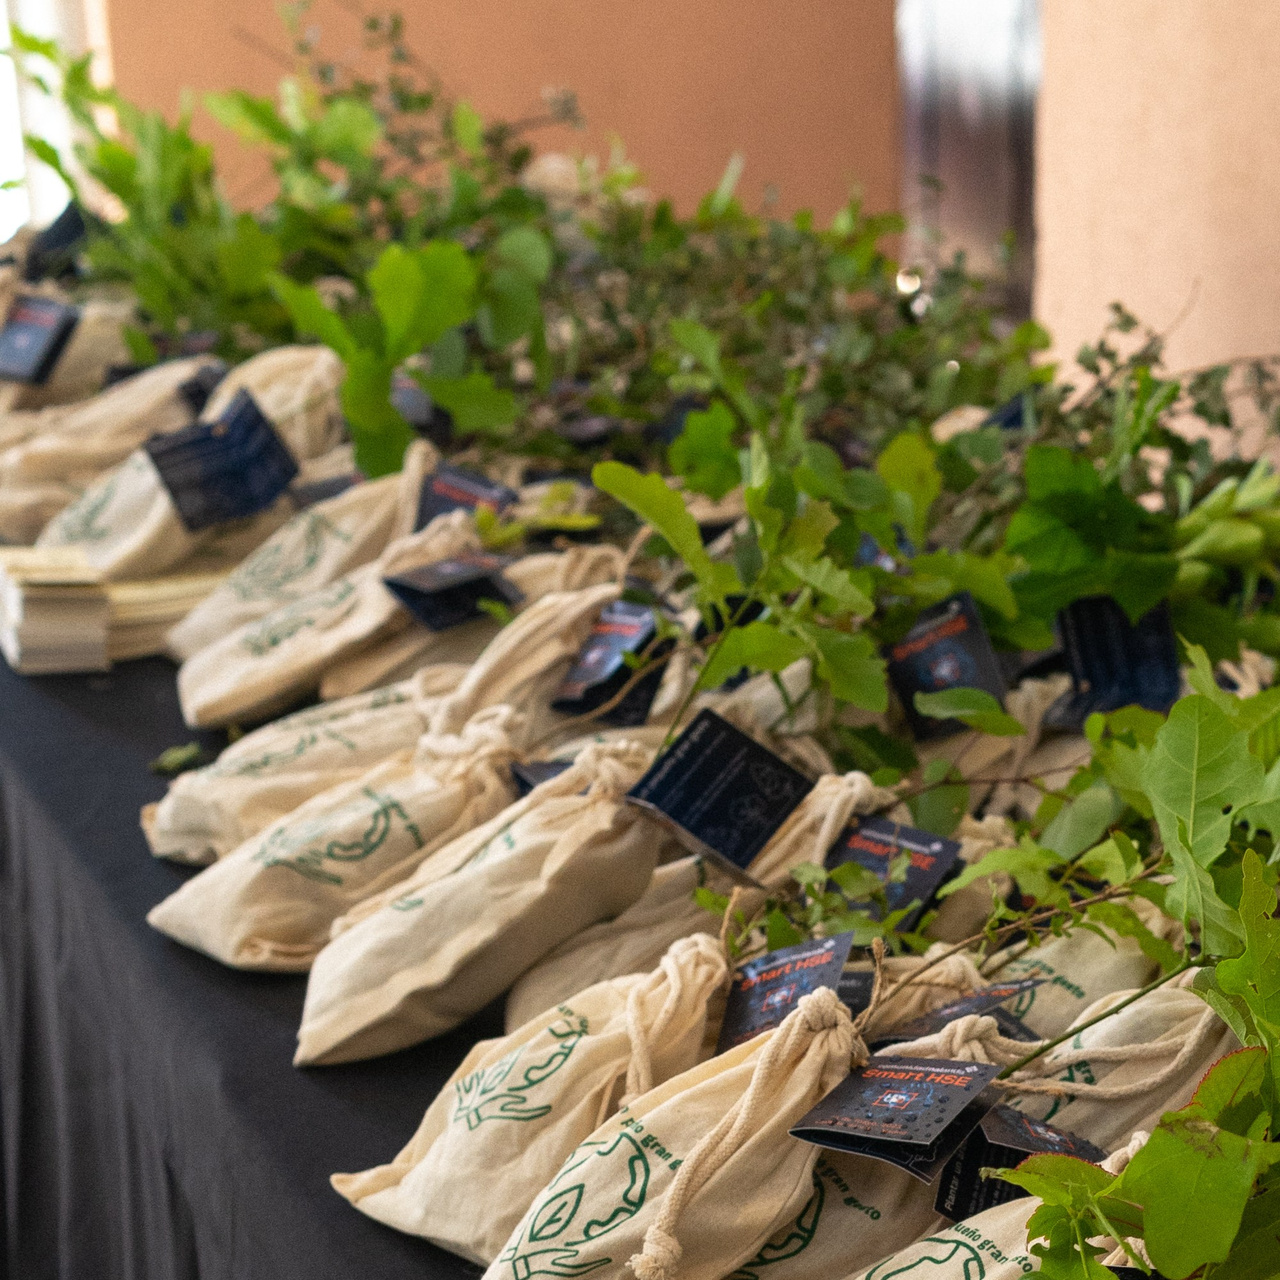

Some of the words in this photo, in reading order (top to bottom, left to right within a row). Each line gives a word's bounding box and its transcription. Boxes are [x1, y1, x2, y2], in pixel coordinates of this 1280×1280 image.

[862, 1068, 926, 1082] Smart
[929, 1071, 973, 1088] HSE
[640, 1129, 672, 1161] gran
